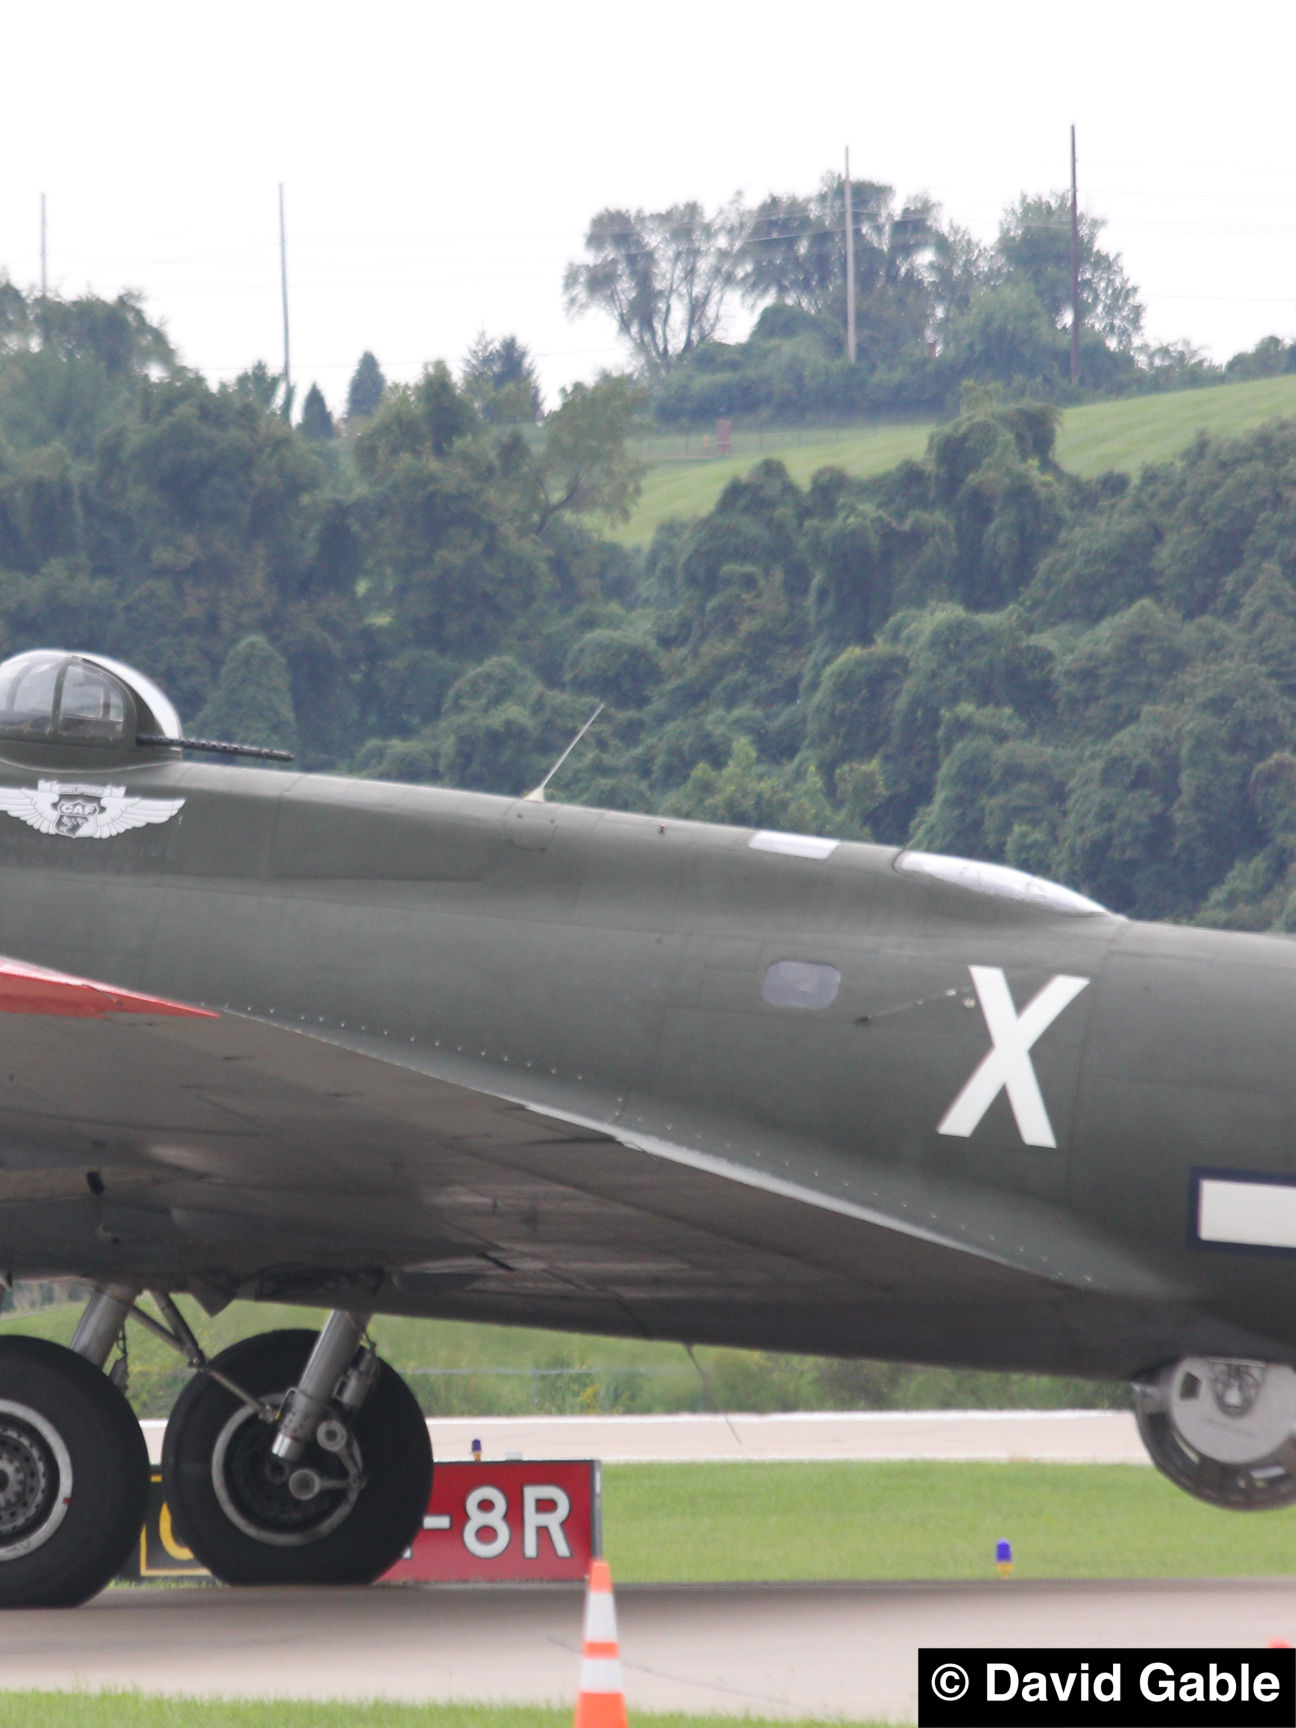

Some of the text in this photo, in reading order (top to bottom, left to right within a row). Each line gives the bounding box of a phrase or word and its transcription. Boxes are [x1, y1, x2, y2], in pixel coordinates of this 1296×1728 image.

[60, 803, 96, 816] CAF
[937, 964, 1090, 1149] X
[402, 1484, 572, 1560] -8R
